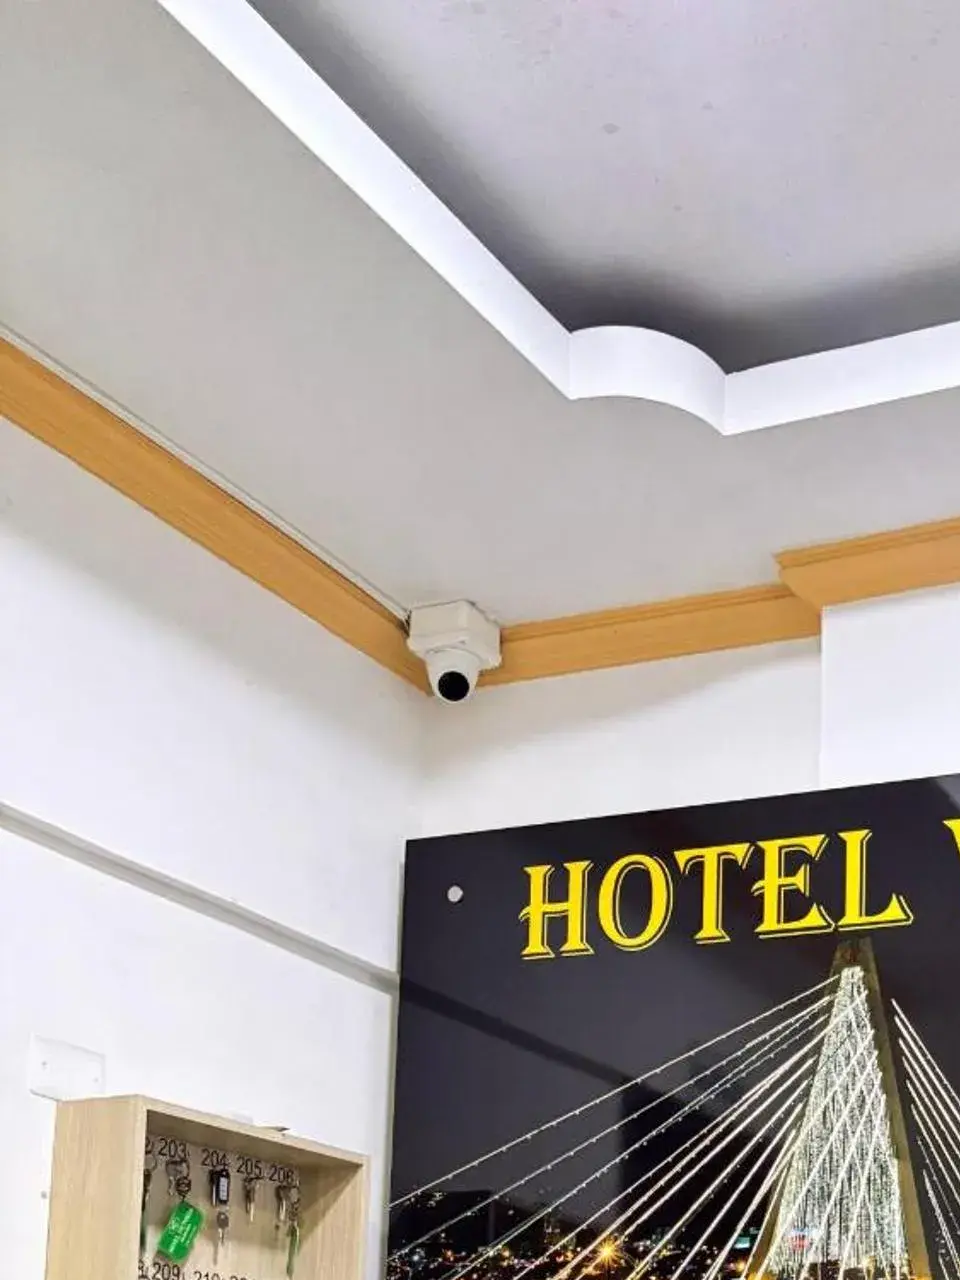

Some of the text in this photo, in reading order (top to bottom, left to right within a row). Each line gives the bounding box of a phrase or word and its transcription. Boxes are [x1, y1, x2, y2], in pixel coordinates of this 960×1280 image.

[518, 829, 914, 960] HOTEL
[158, 1138, 188, 1160] 203
[202, 1148, 229, 1168] 204
[236, 1156, 263, 1177] 205
